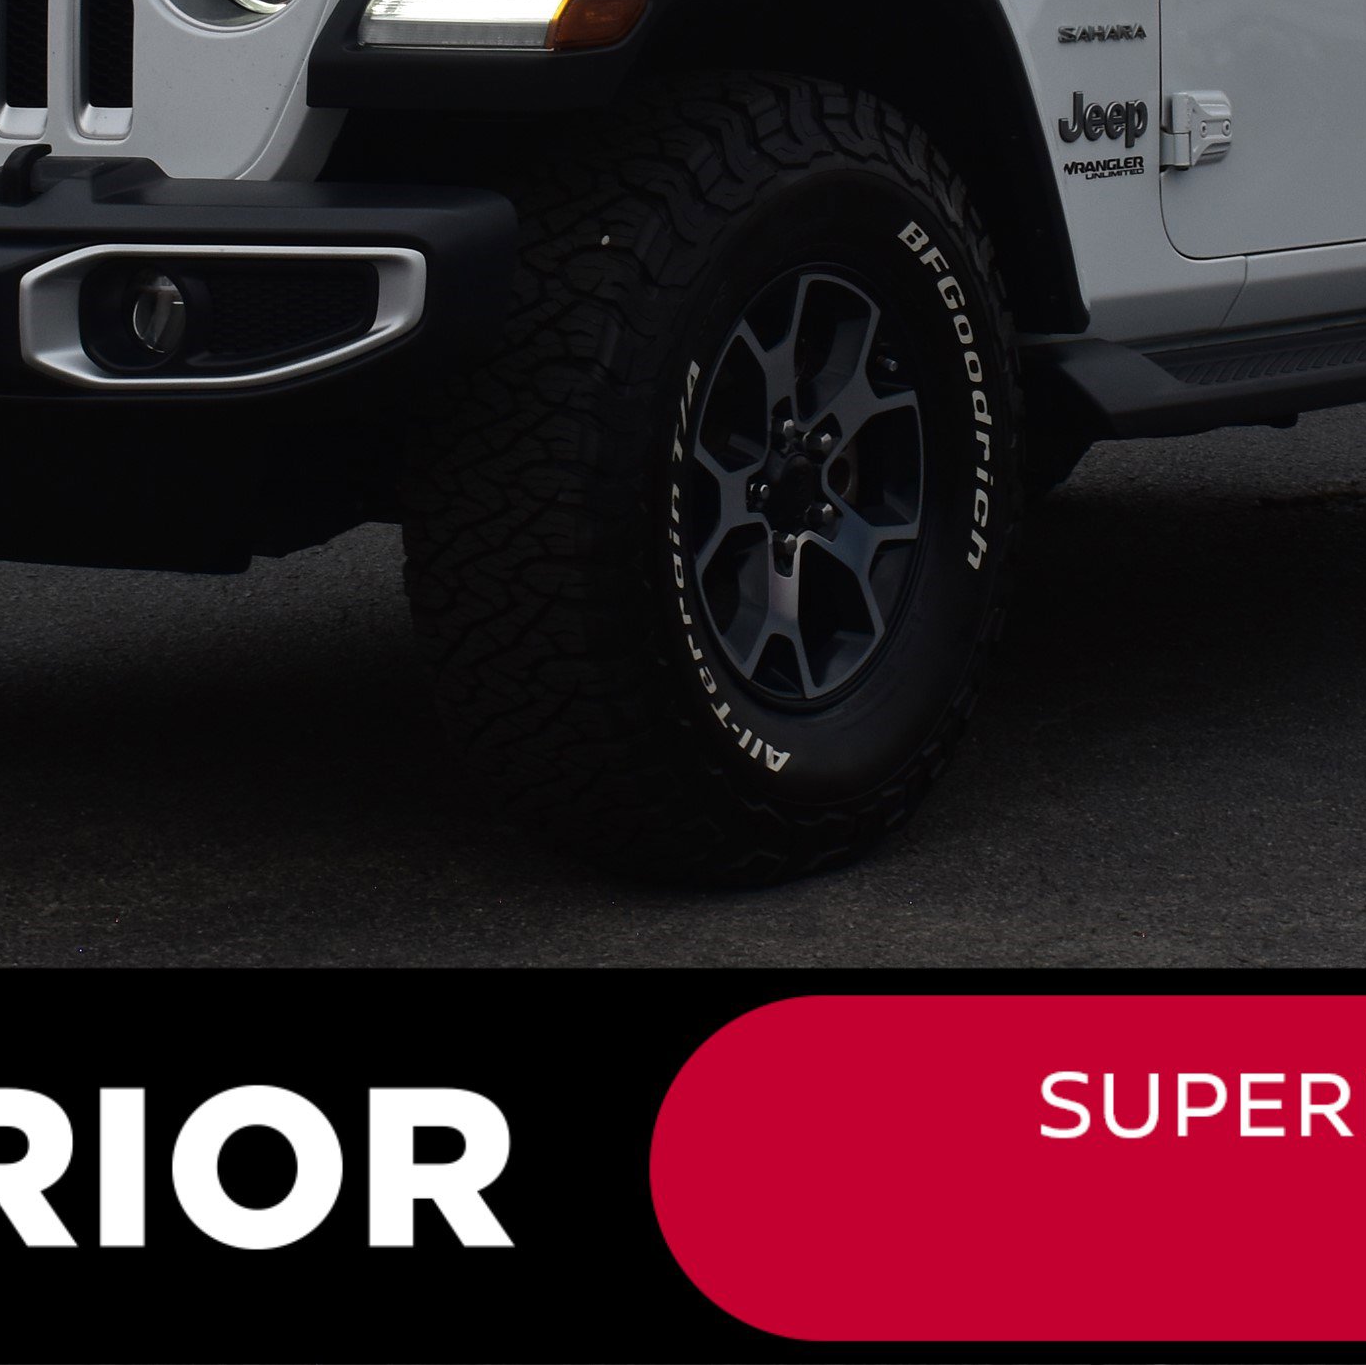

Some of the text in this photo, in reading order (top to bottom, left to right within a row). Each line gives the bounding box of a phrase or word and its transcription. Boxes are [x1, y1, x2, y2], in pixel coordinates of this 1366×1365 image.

[1058, 23, 1147, 44] SAHARA
[1058, 91, 1148, 149] Jeep
[1063, 156, 1145, 176] WRANGLER
[1085, 168, 1145, 181] UNLIMITED
[896, 220, 994, 571] BFGoodrich
[669, 481, 792, 773] All-Terrain
